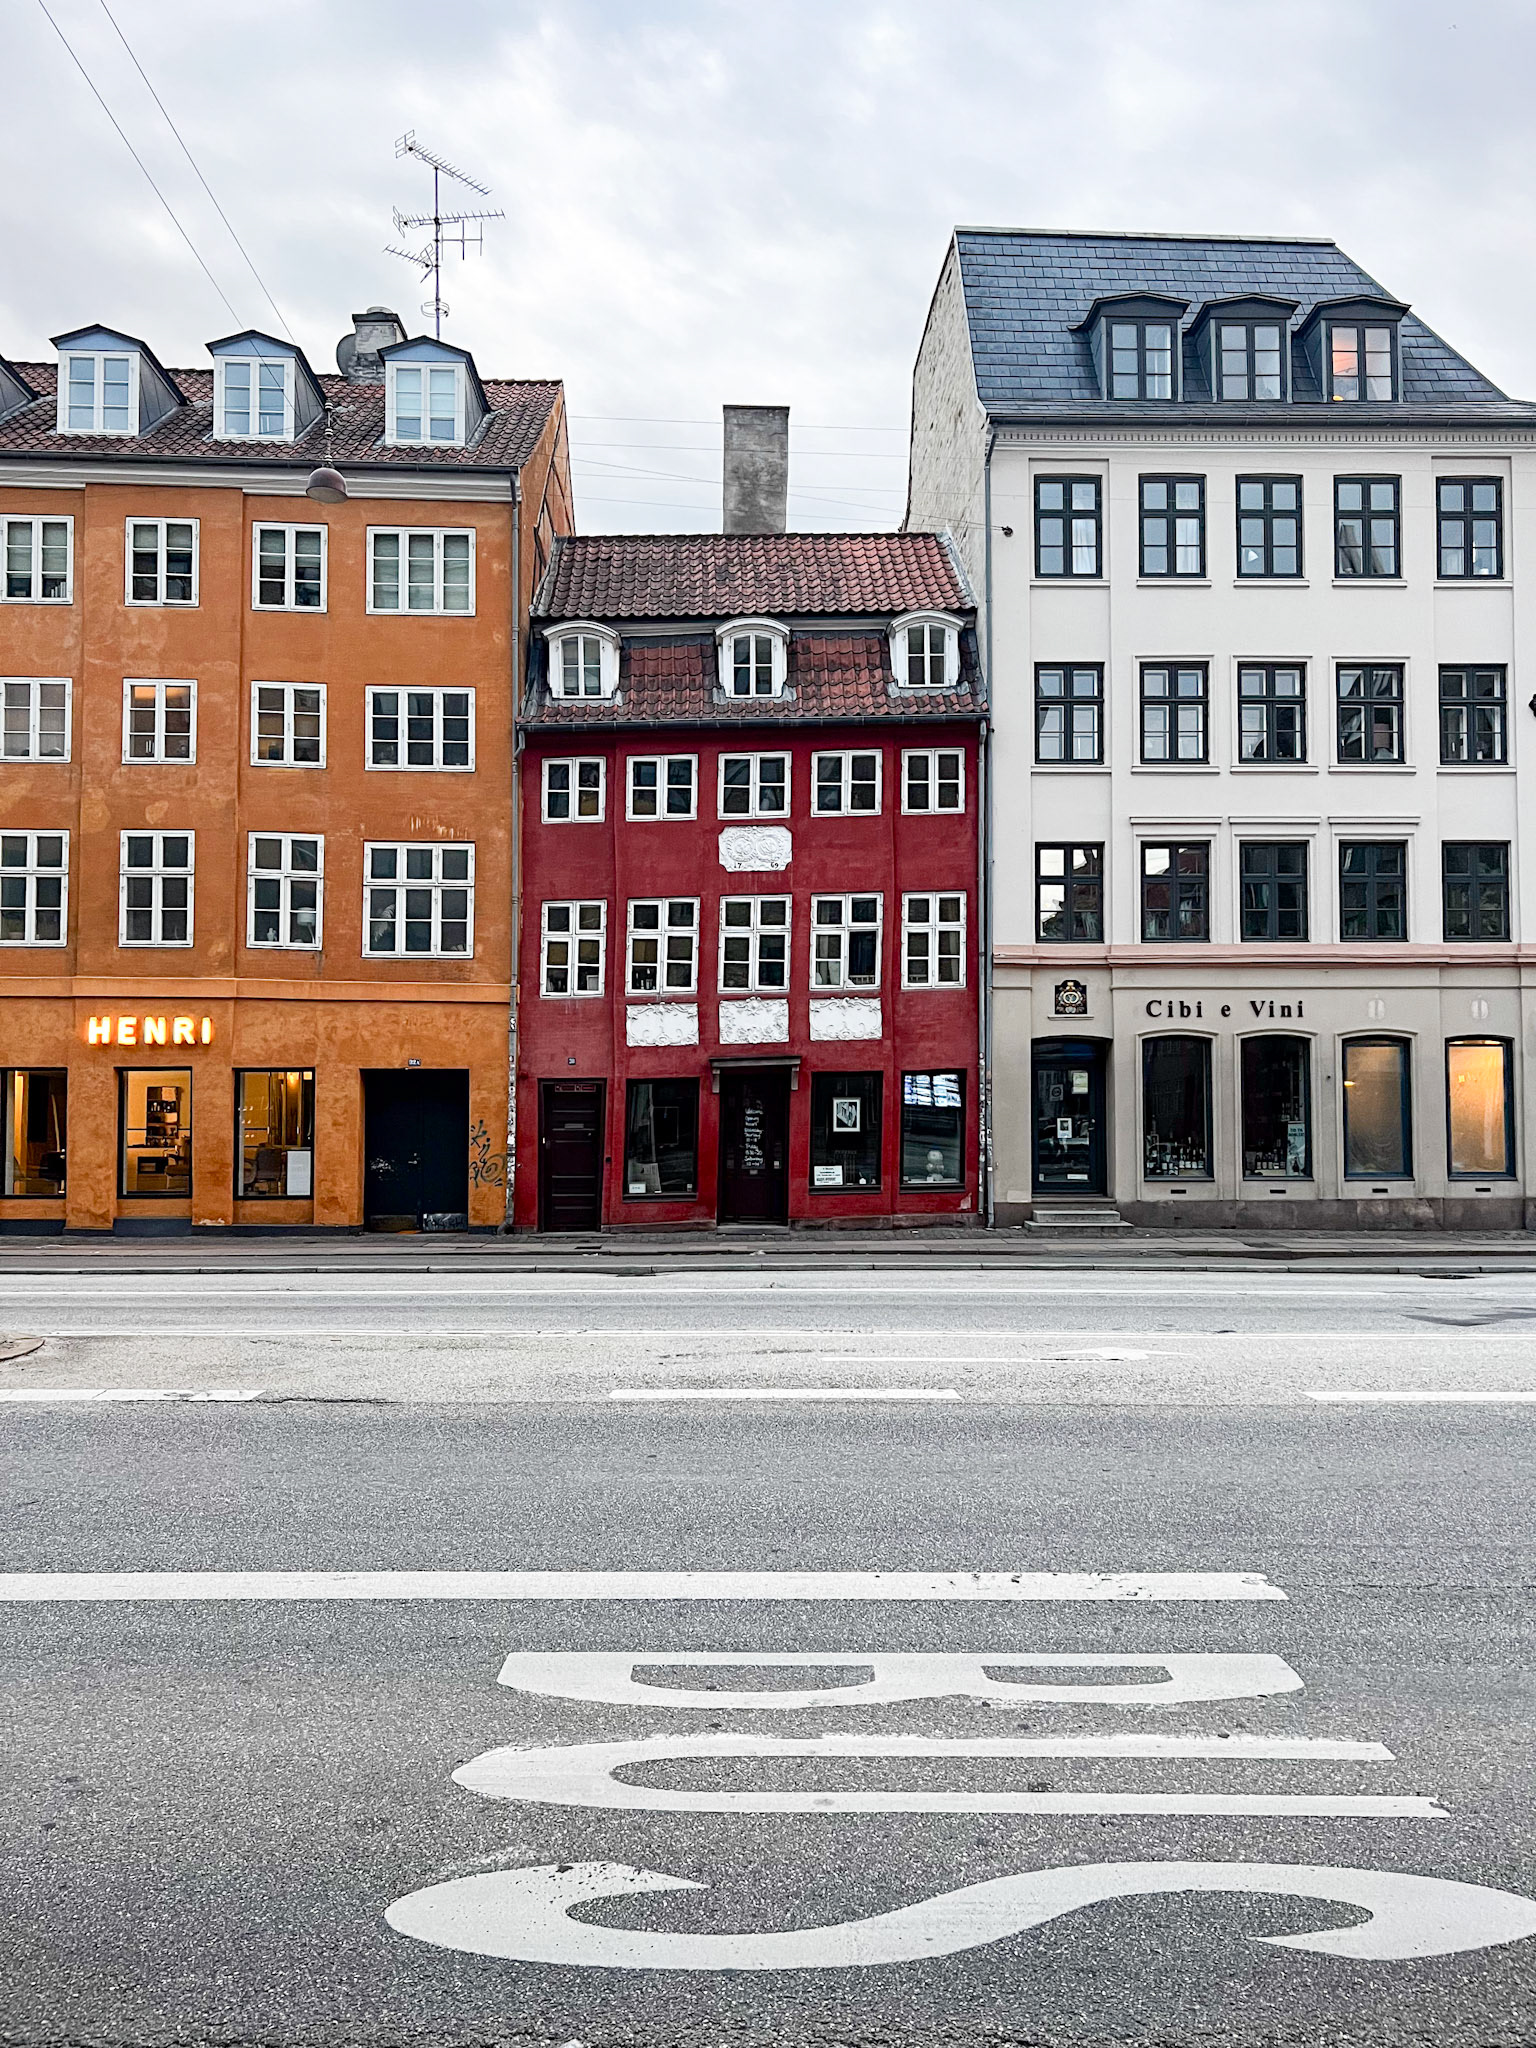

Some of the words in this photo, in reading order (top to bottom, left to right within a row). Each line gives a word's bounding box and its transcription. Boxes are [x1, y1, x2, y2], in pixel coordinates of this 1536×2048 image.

[1145, 999, 1203, 1018] Cibi
[1220, 1004, 1231, 1018] e
[1249, 999, 1304, 1018] Vini
[88, 1015, 212, 1045] HENRI
[384, 1651, 1536, 1970] BUS
